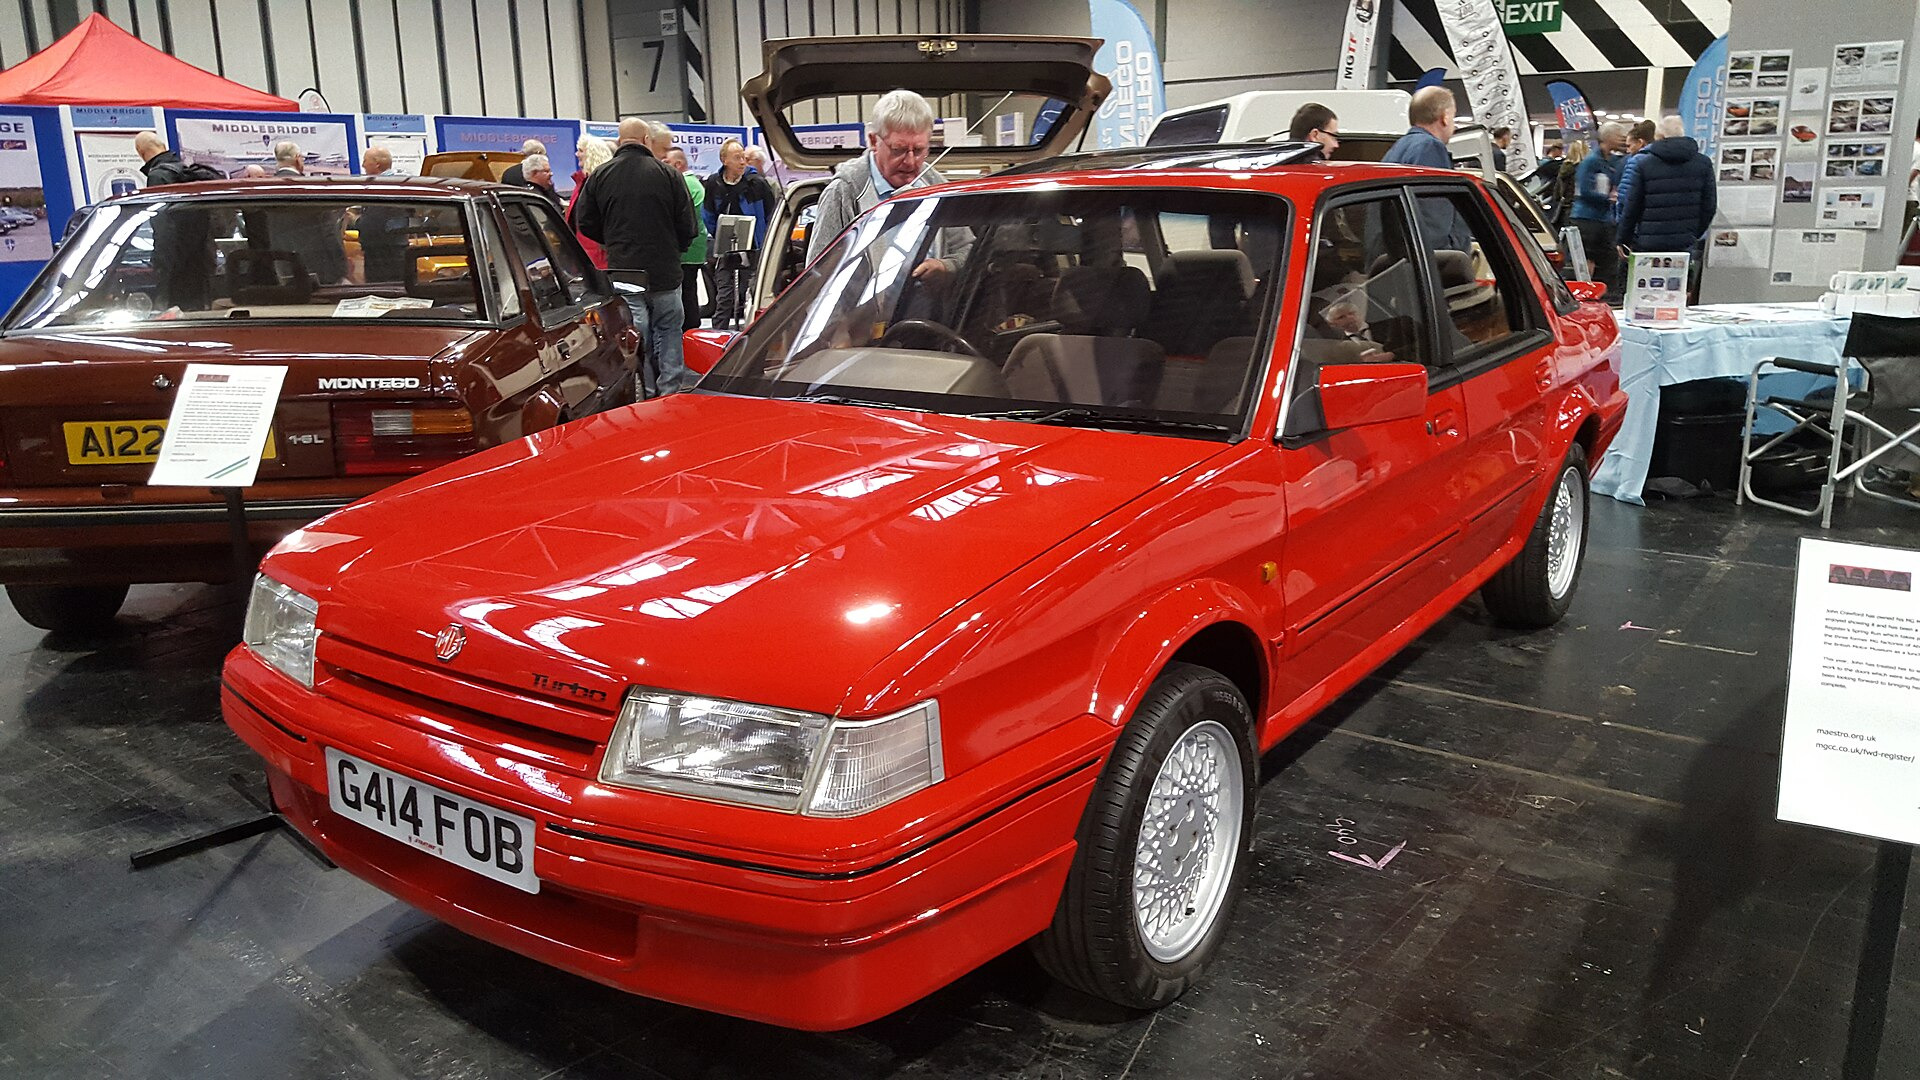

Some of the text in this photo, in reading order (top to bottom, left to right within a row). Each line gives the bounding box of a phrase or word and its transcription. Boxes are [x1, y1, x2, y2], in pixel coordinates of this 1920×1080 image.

[1505, 1, 1560, 24] EXIT
[642, 40, 665, 93] 7
[75, 107, 146, 115] MIDDLEBRIDGE
[212, 124, 317, 134] MIDDLEBRIDGE
[672, 135, 738, 145] DLEBRID
[318, 377, 420, 390] MONTEGO
[81, 425, 165, 457] A122
[532, 672, 608, 701] Turbo
[1816, 728, 1877, 742] maestro.org.uk
[1815, 742, 1915, 763] mgcc.co.uk/fwd-register/
[338, 759, 523, 874] G414 FOB
